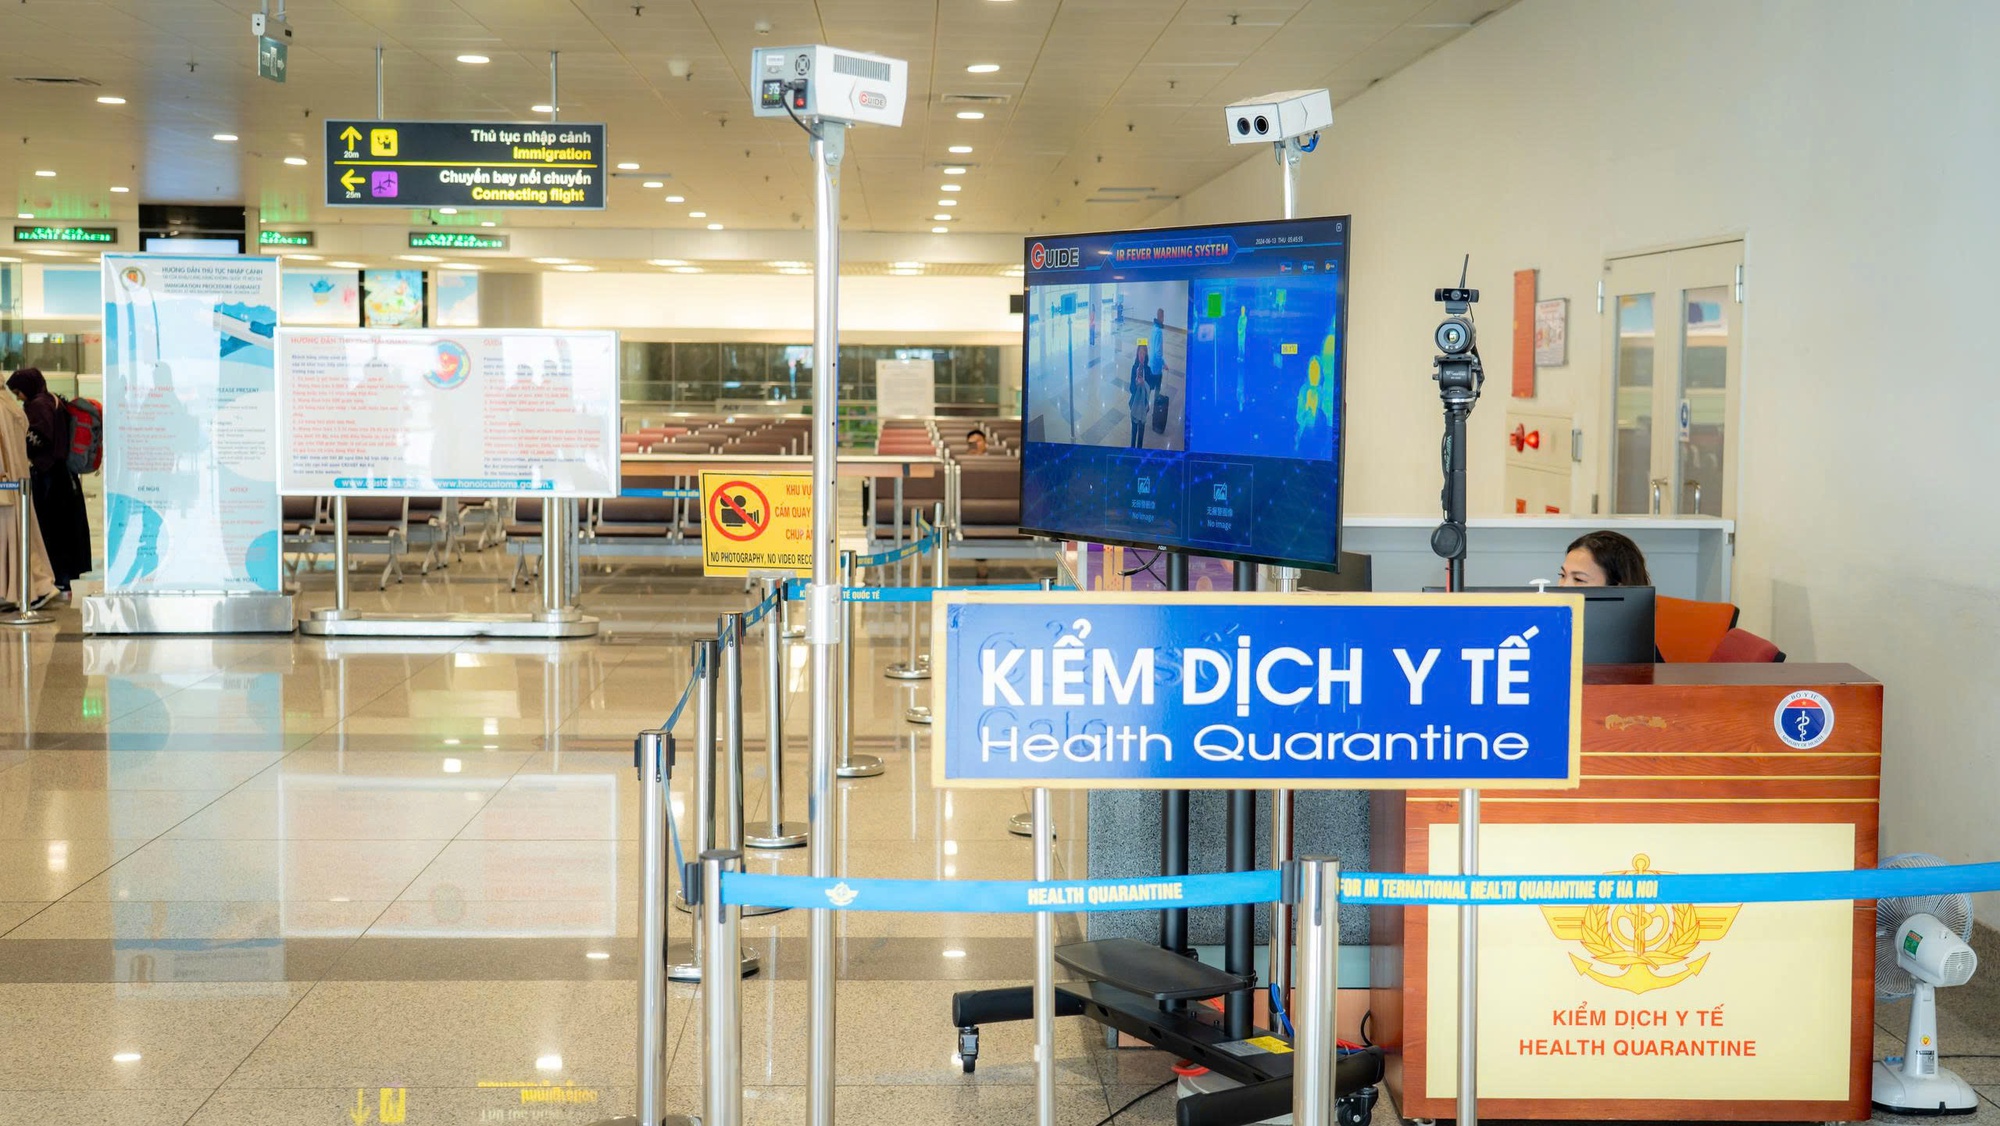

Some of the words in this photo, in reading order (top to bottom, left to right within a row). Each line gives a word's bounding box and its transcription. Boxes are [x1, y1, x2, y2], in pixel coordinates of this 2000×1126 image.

[859, 91, 885, 106] GUIDE
[471, 129, 497, 142] Thủ
[499, 131, 520, 145] tục
[524, 130, 556, 145] nhập
[559, 129, 591, 144] cảnh
[343, 151, 360, 159] 20m
[513, 147, 591, 162] Immigration
[493, 171, 517, 186] bay
[472, 188, 548, 203] Connecting
[550, 188, 585, 203] flight
[1031, 242, 1079, 269] GUIDE
[1116, 250, 1125, 261] IR
[1126, 248, 1152, 261] FEVER
[1153, 246, 1193, 259] WARNING
[1195, 243, 1229, 258] SYSTEM
[786, 485, 800, 496] KHU
[792, 506, 812, 518] QUAY
[1131, 512, 1139, 520] No
[1207, 520, 1215, 528] No
[786, 528, 804, 544] CHỤP
[711, 552, 720, 562] NO
[721, 552, 766, 565] PHOTOGRAPHY,
[767, 553, 777, 564] NO
[777, 553, 796, 564] VIDEO
[851, 589, 871, 600] QUỐC
[872, 588, 881, 600] TẾ
[983, 618, 1154, 706] KIỂM
[1183, 635, 1362, 717] DỊCH
[1392, 648, 1442, 706] Y
[1461, 625, 1540, 706] TẾ
[981, 725, 1172, 762] Health
[1193, 723, 1530, 762] Quarantine
[1807, 735, 1824, 747] HEALTH
[1028, 887, 1084, 905] HEALTH
[1088, 882, 1183, 905] QUARANTINE
[1364, 878, 1380, 898] IN
[1382, 879, 1467, 900] TERNATIONAL
[1470, 880, 1516, 900] HEALTH
[1519, 880, 1596, 900] QUARANTINE
[1598, 880, 1614, 899] OF
[1616, 880, 1634, 899] HA
[1636, 880, 1658, 898] NOI
[1553, 1001, 1606, 1026] KIỂM
[1615, 1010, 1667, 1030] DỊCH
[1676, 1010, 1689, 1026] Y
[1696, 1003, 1725, 1027] TẾ
[1519, 1039, 1605, 1056] HEALTH
[1613, 1039, 1757, 1057] QUARANTINE
